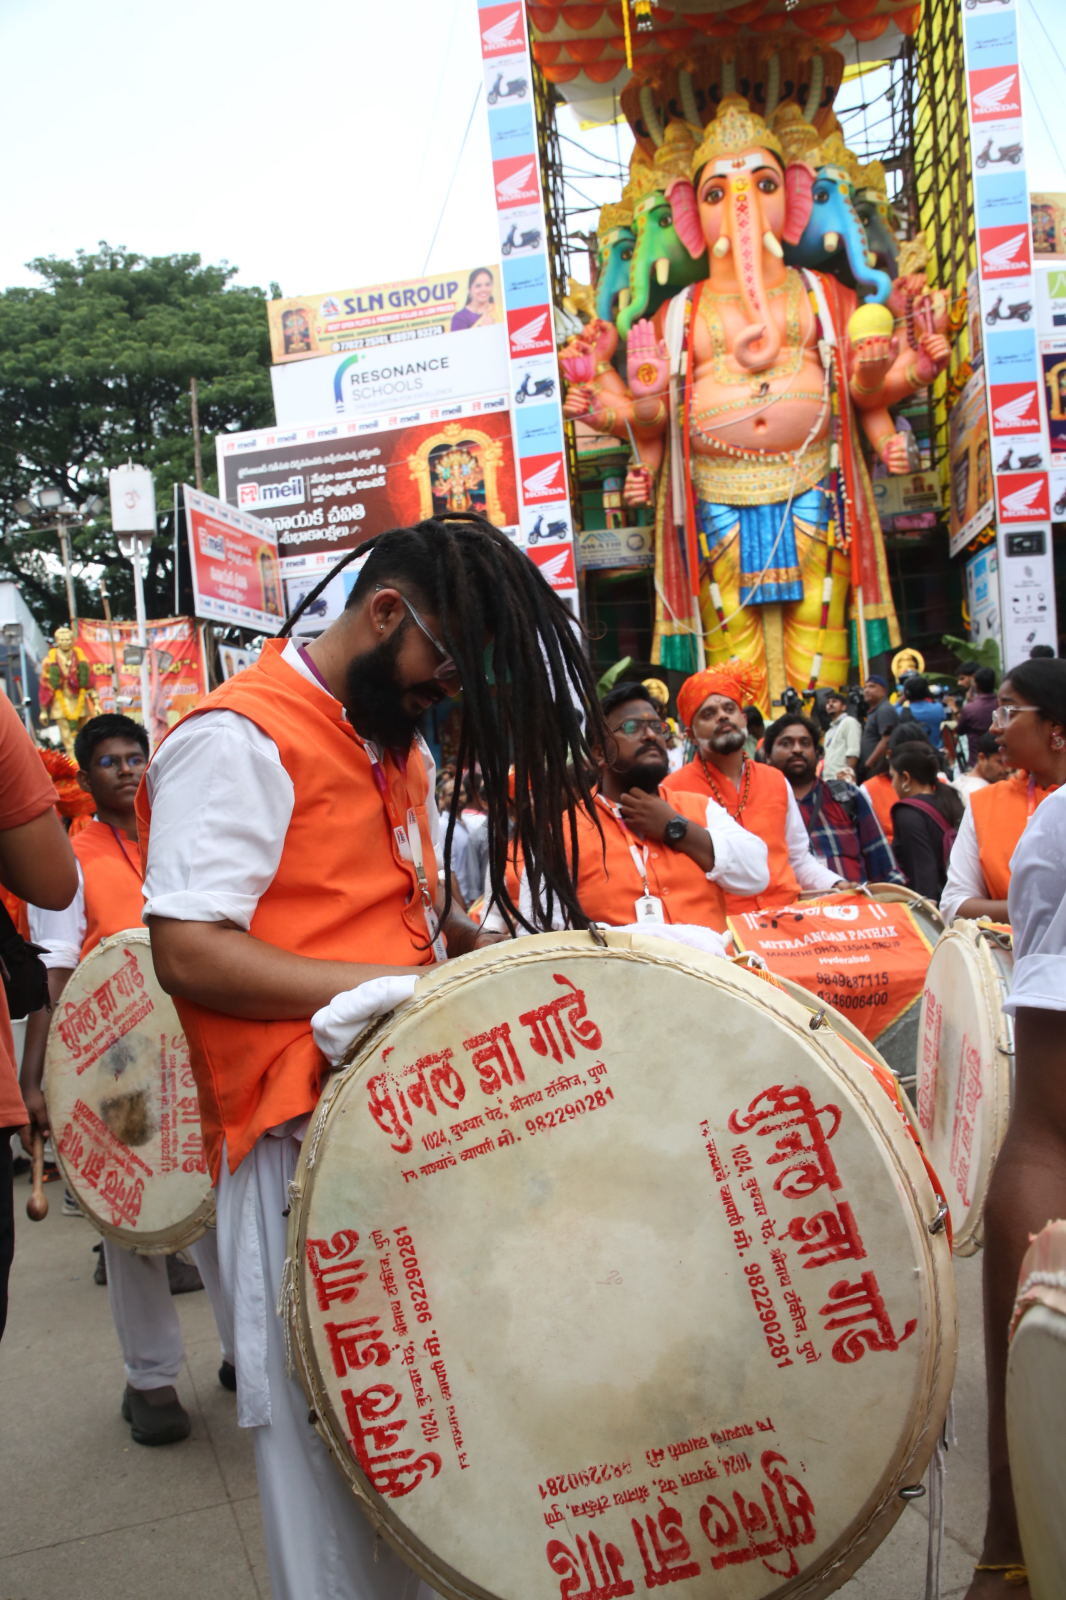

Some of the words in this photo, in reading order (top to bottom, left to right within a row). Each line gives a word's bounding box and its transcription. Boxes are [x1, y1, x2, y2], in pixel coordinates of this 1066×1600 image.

[483, 38, 524, 52] HONDA
[975, 102, 1019, 116] HONDA
[497, 190, 539, 205] HONDA
[983, 260, 1029, 273] HONDA
[344, 293, 384, 315] SLN
[388, 281, 459, 308] GROUP
[511, 338, 552, 352] HONDA
[350, 356, 449, 386] RESONANCE
[352, 377, 423, 402] SCHOOLS
[484, 397, 505, 410] meil
[994, 417, 1039, 430] HONDA
[262, 477, 303, 501] meil
[524, 486, 566, 500] HONDA
[327, 503, 367, 524] చవితి
[1002, 507, 1046, 519] HONDA
[758, 929, 848, 950] MITRAANGAN
[848, 925, 898, 941] PATHAK
[818, 954, 870, 965] Hyderabad
[518, 974, 602, 1064] गाडे
[587, 1062, 608, 1084] पुणे
[525, 1088, 614, 1136] 982290281
[727, 1085, 843, 1199] सुनिल
[818, 1271, 918, 1363] गाडे
[371, 1230, 390, 1250] पुणे
[392, 1226, 433, 1323] 982290281
[743, 1262, 793, 1367] 982290281
[796, 1341, 820, 1363] पुणे
[544, 1504, 565, 1528] पुणे
[699, 1450, 816, 1578] सुनिल
